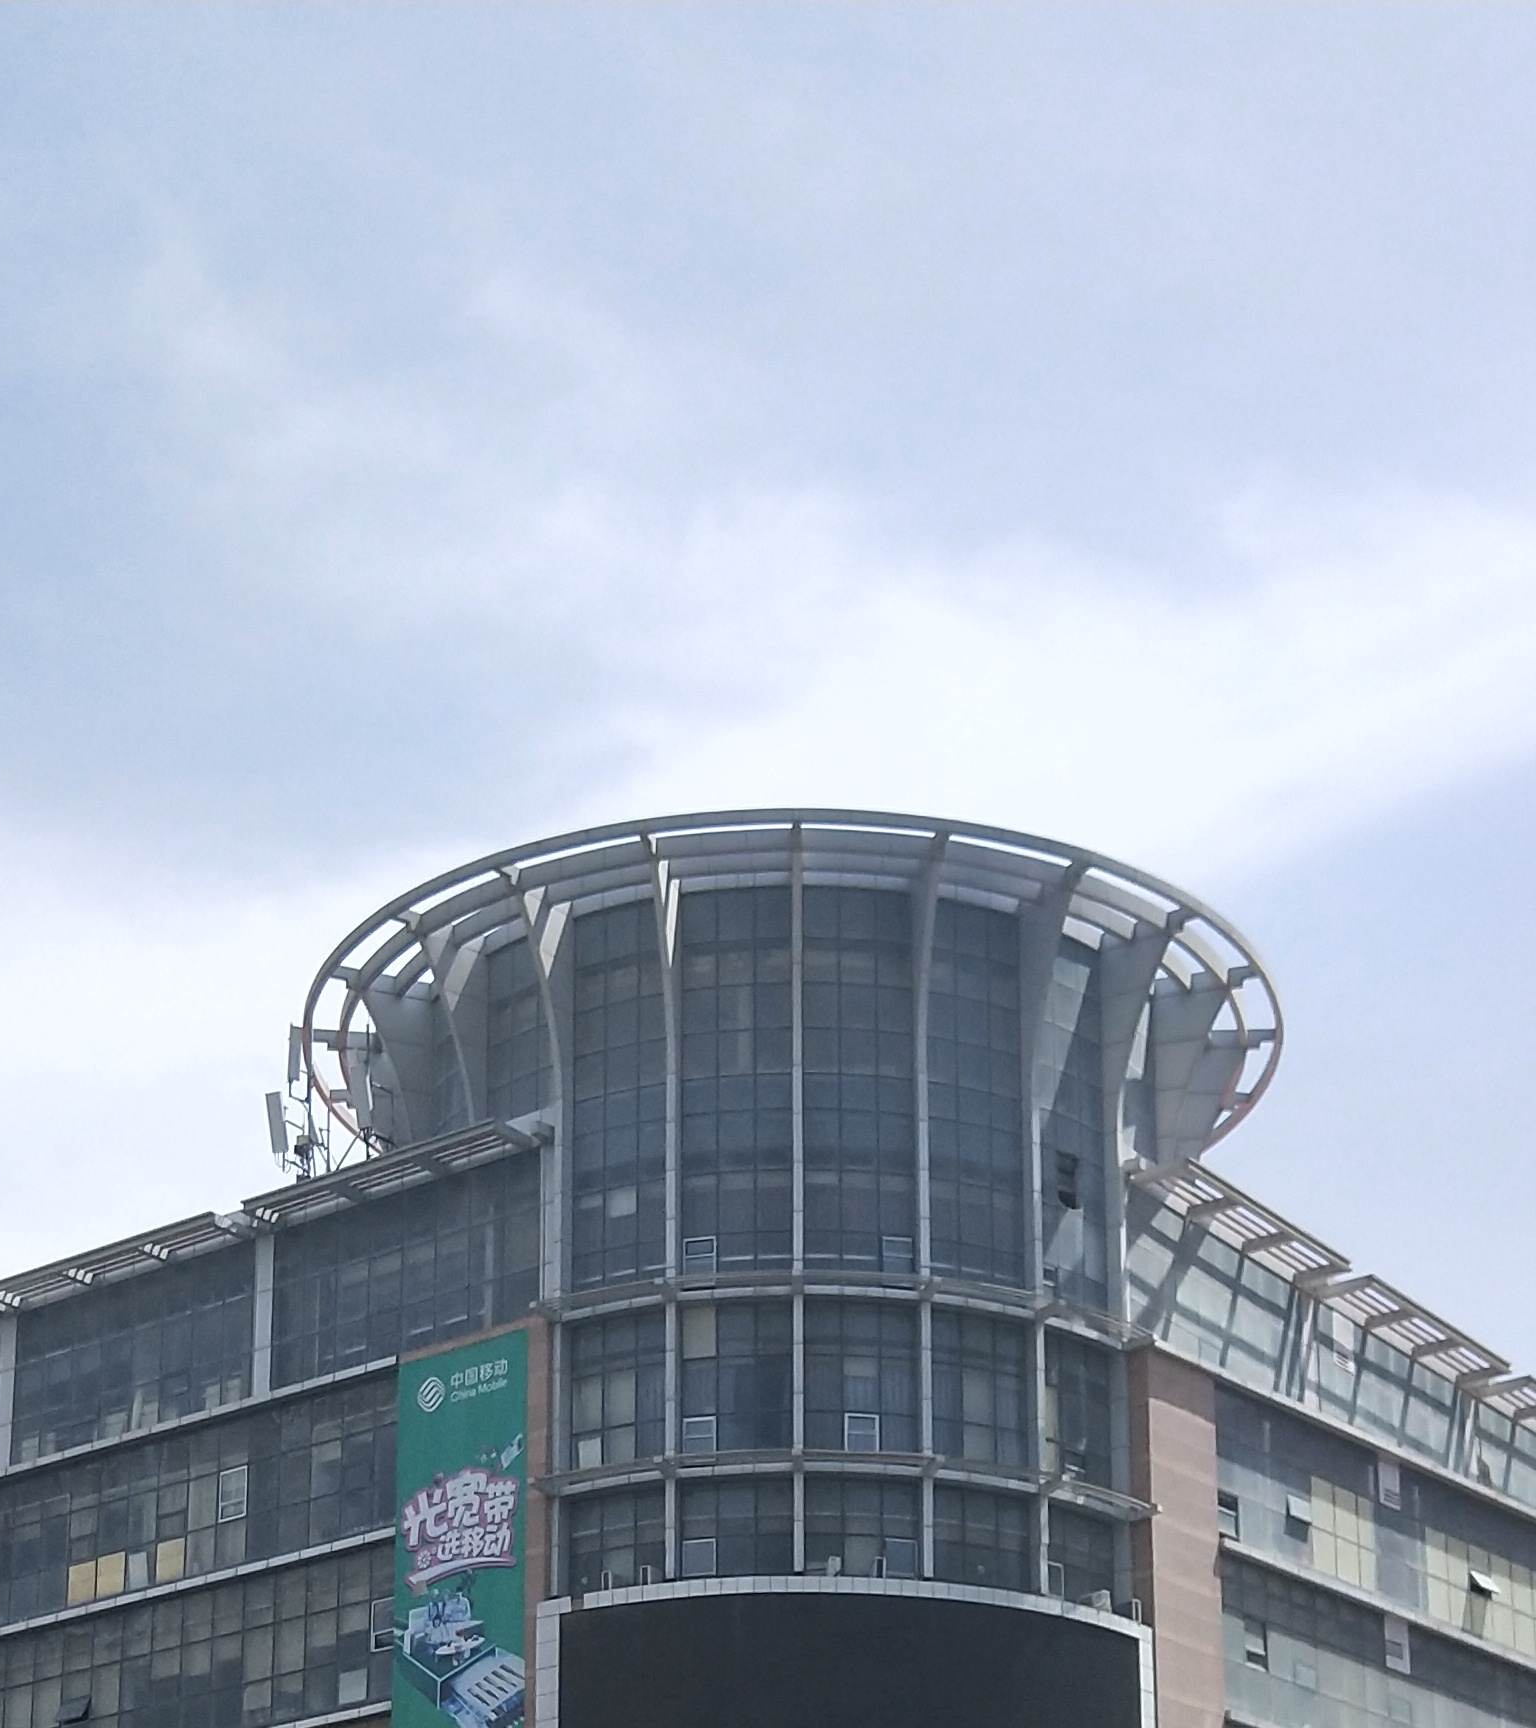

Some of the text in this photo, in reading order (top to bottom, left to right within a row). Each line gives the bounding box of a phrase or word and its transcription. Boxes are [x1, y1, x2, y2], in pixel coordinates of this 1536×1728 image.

[451, 1358, 508, 1388] 中国移动
[451, 1378, 508, 1402] China Mobile
[404, 1471, 516, 1547] 光宽带
